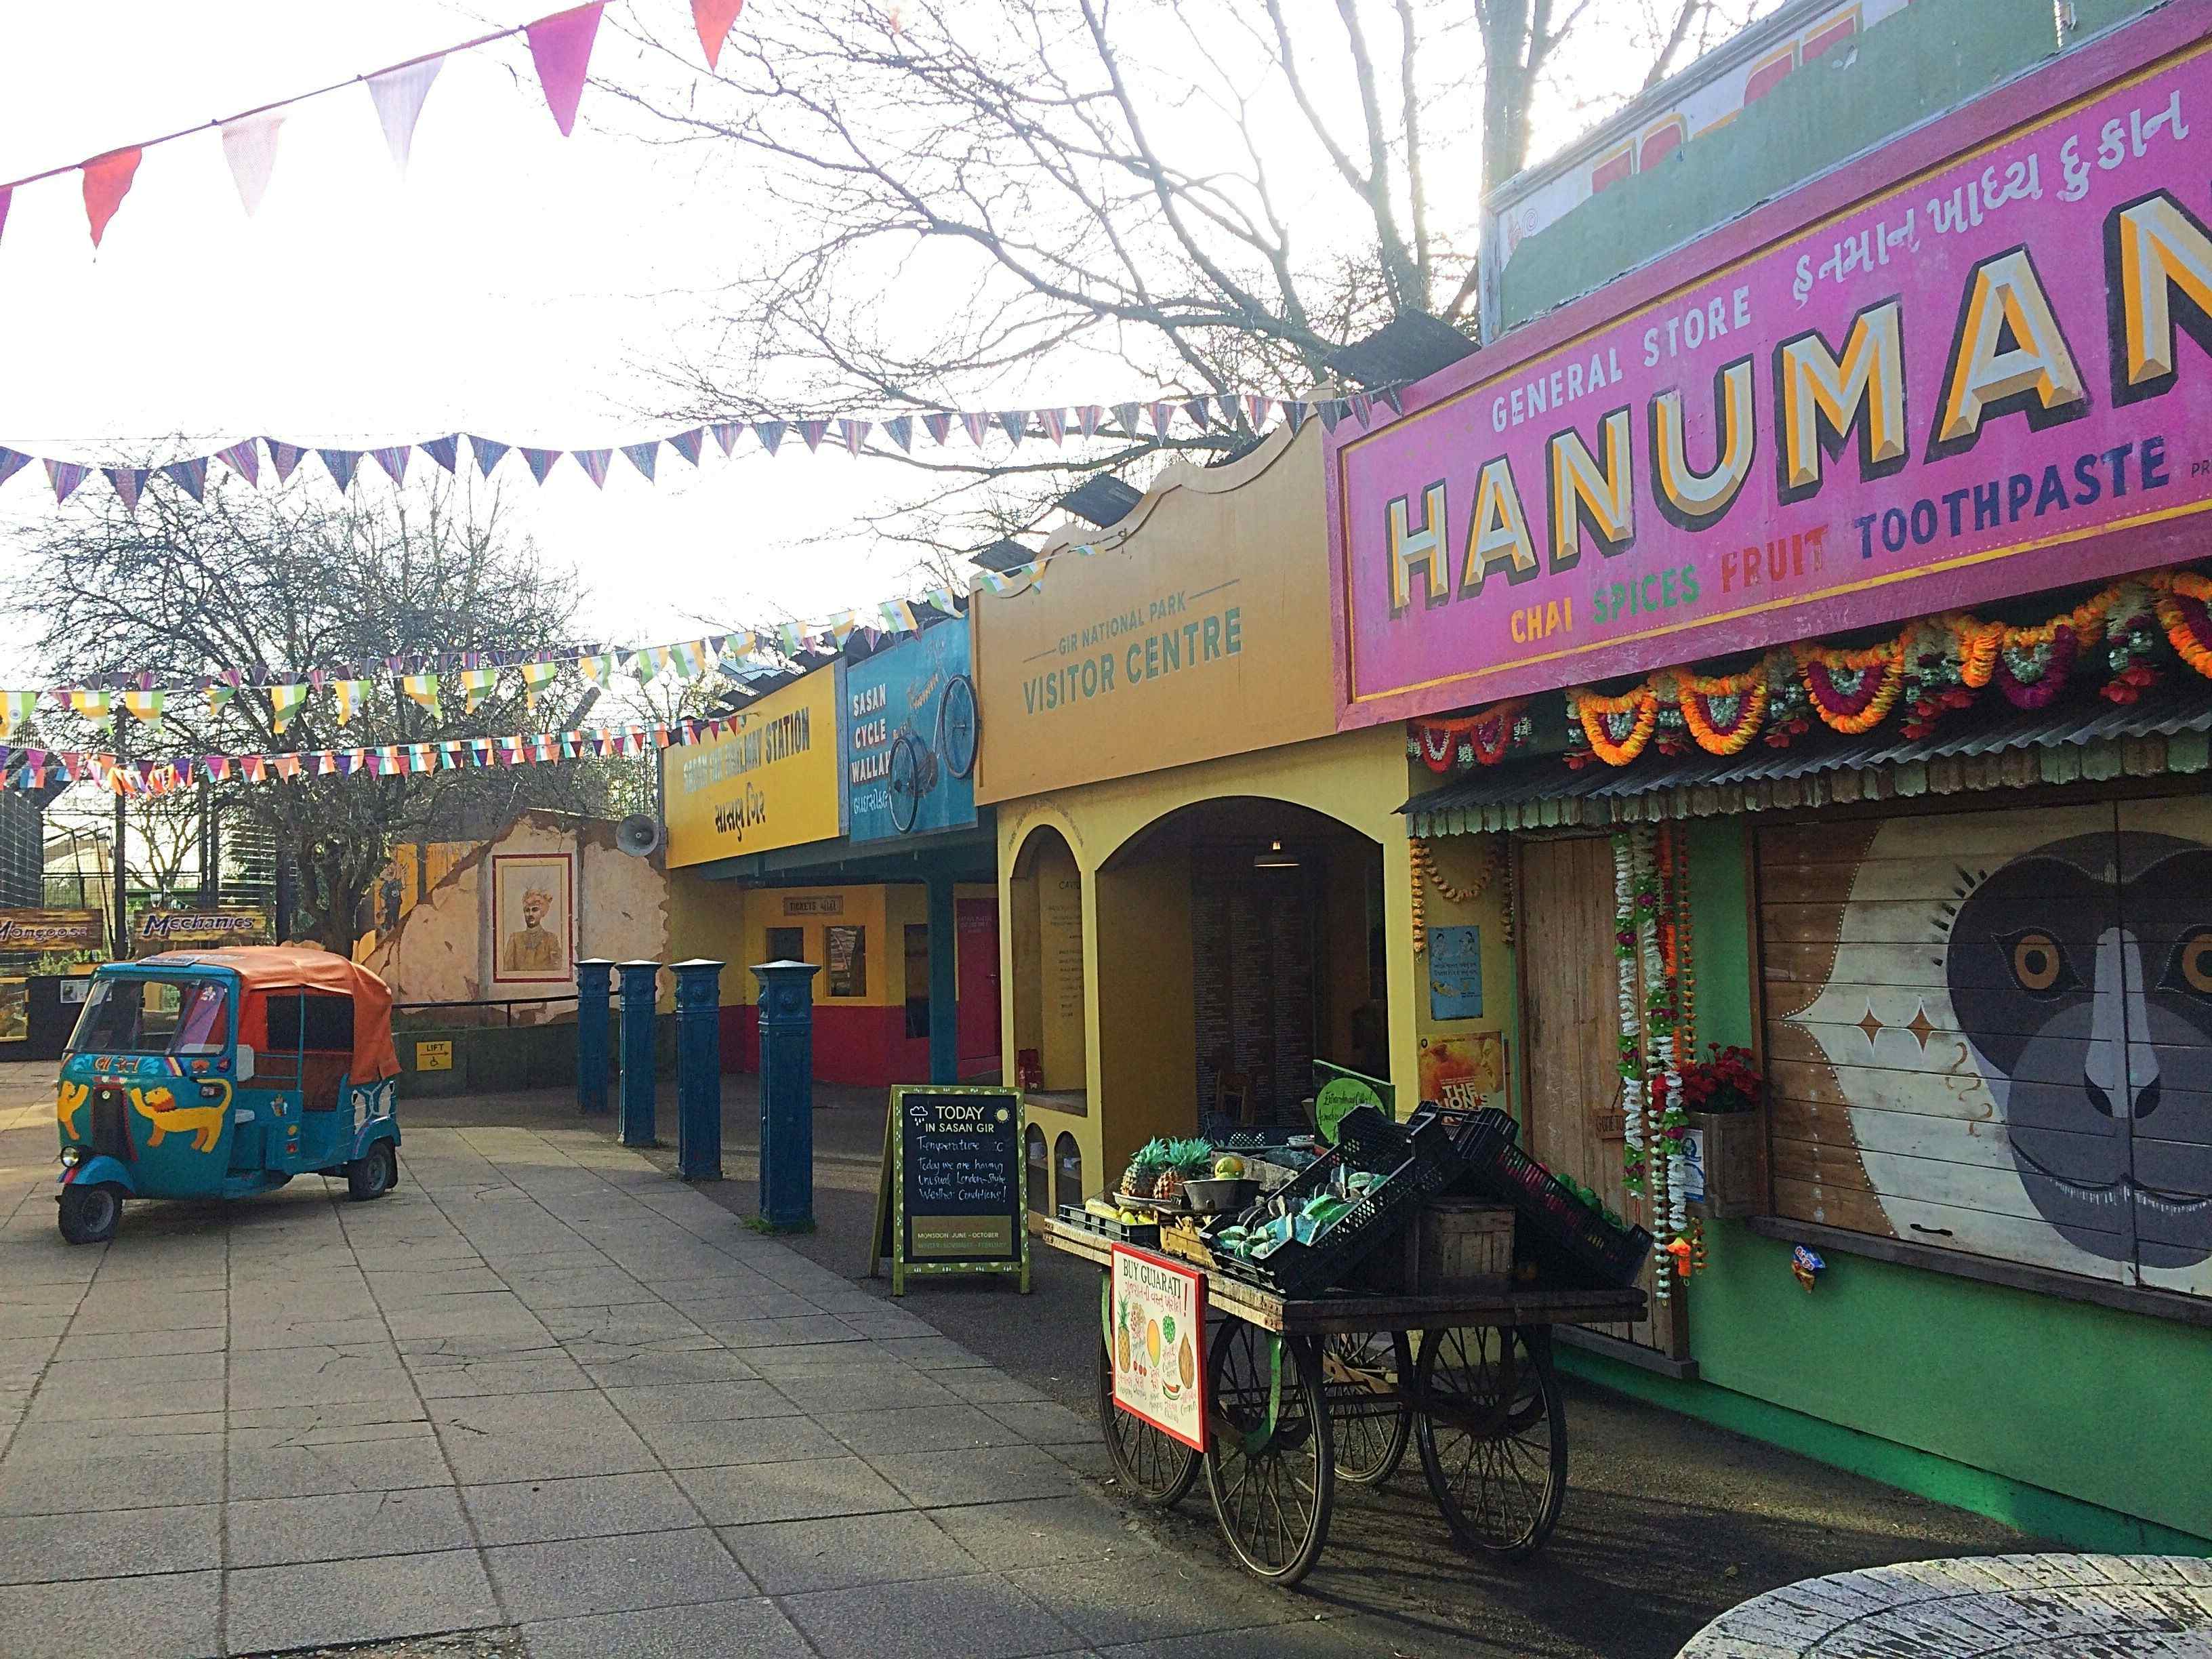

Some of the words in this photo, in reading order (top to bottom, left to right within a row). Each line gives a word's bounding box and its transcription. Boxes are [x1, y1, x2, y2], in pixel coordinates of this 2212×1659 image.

[1492, 347, 1623, 433] GENERAL
[1643, 285, 1751, 367] STORE
[1385, 188, 2212, 620] HANUMAN
[1511, 596, 1574, 644] CHAI
[1593, 563, 1701, 625] SPICES
[1721, 525, 1828, 594] FRUIT
[1854, 436, 2170, 559] TOOTHPASTE
[1058, 634, 1078, 656] GIR
[1082, 609, 1145, 647] NATIONAL
[1149, 591, 1186, 623] PARK
[1023, 653, 1115, 716] VISITOR
[1125, 607, 1242, 685] CENTRE
[853, 683, 887, 716] SASAN
[766, 707, 811, 764] STATION
[855, 718, 886, 750] CYCLE
[790, 901, 817, 912] TICKETS
[141, 914, 255, 937] Mechanics
[1442, 1082, 1477, 1099] THE
[925, 1123, 935, 1132] IN
[939, 1123, 972, 1132] SASAN
[977, 1123, 995, 1133] GIR
[935, 1106, 985, 1120] TODAY
[916, 1135, 980, 1152] Temperature
[918, 1158, 940, 1175] Today
[943, 1162, 953, 1170] we
[956, 1161, 971, 1170] are
[975, 1159, 1004, 1174] having
[1123, 1258, 1139, 1280] BUY
[1141, 1265, 1181, 1297] GUJARATI
